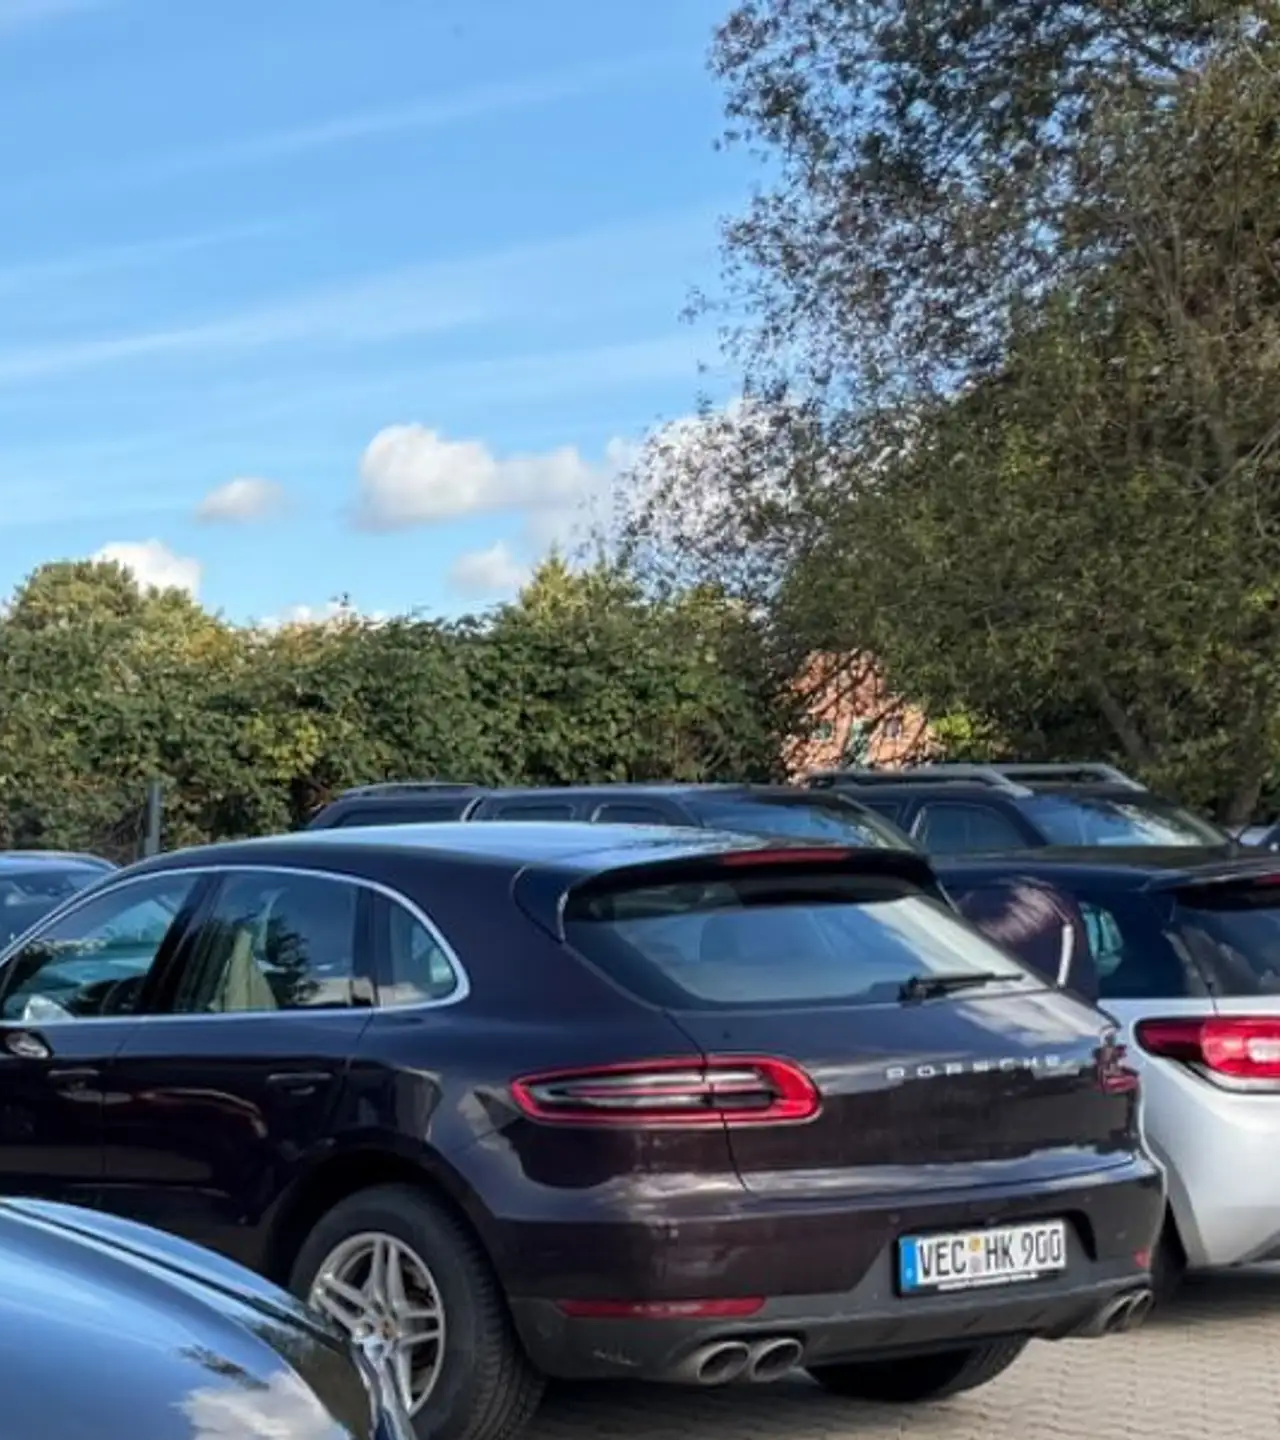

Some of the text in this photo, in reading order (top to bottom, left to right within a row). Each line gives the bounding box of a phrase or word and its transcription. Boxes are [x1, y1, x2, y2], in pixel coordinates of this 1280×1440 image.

[918, 1228, 1062, 1278] VEC HK 900
